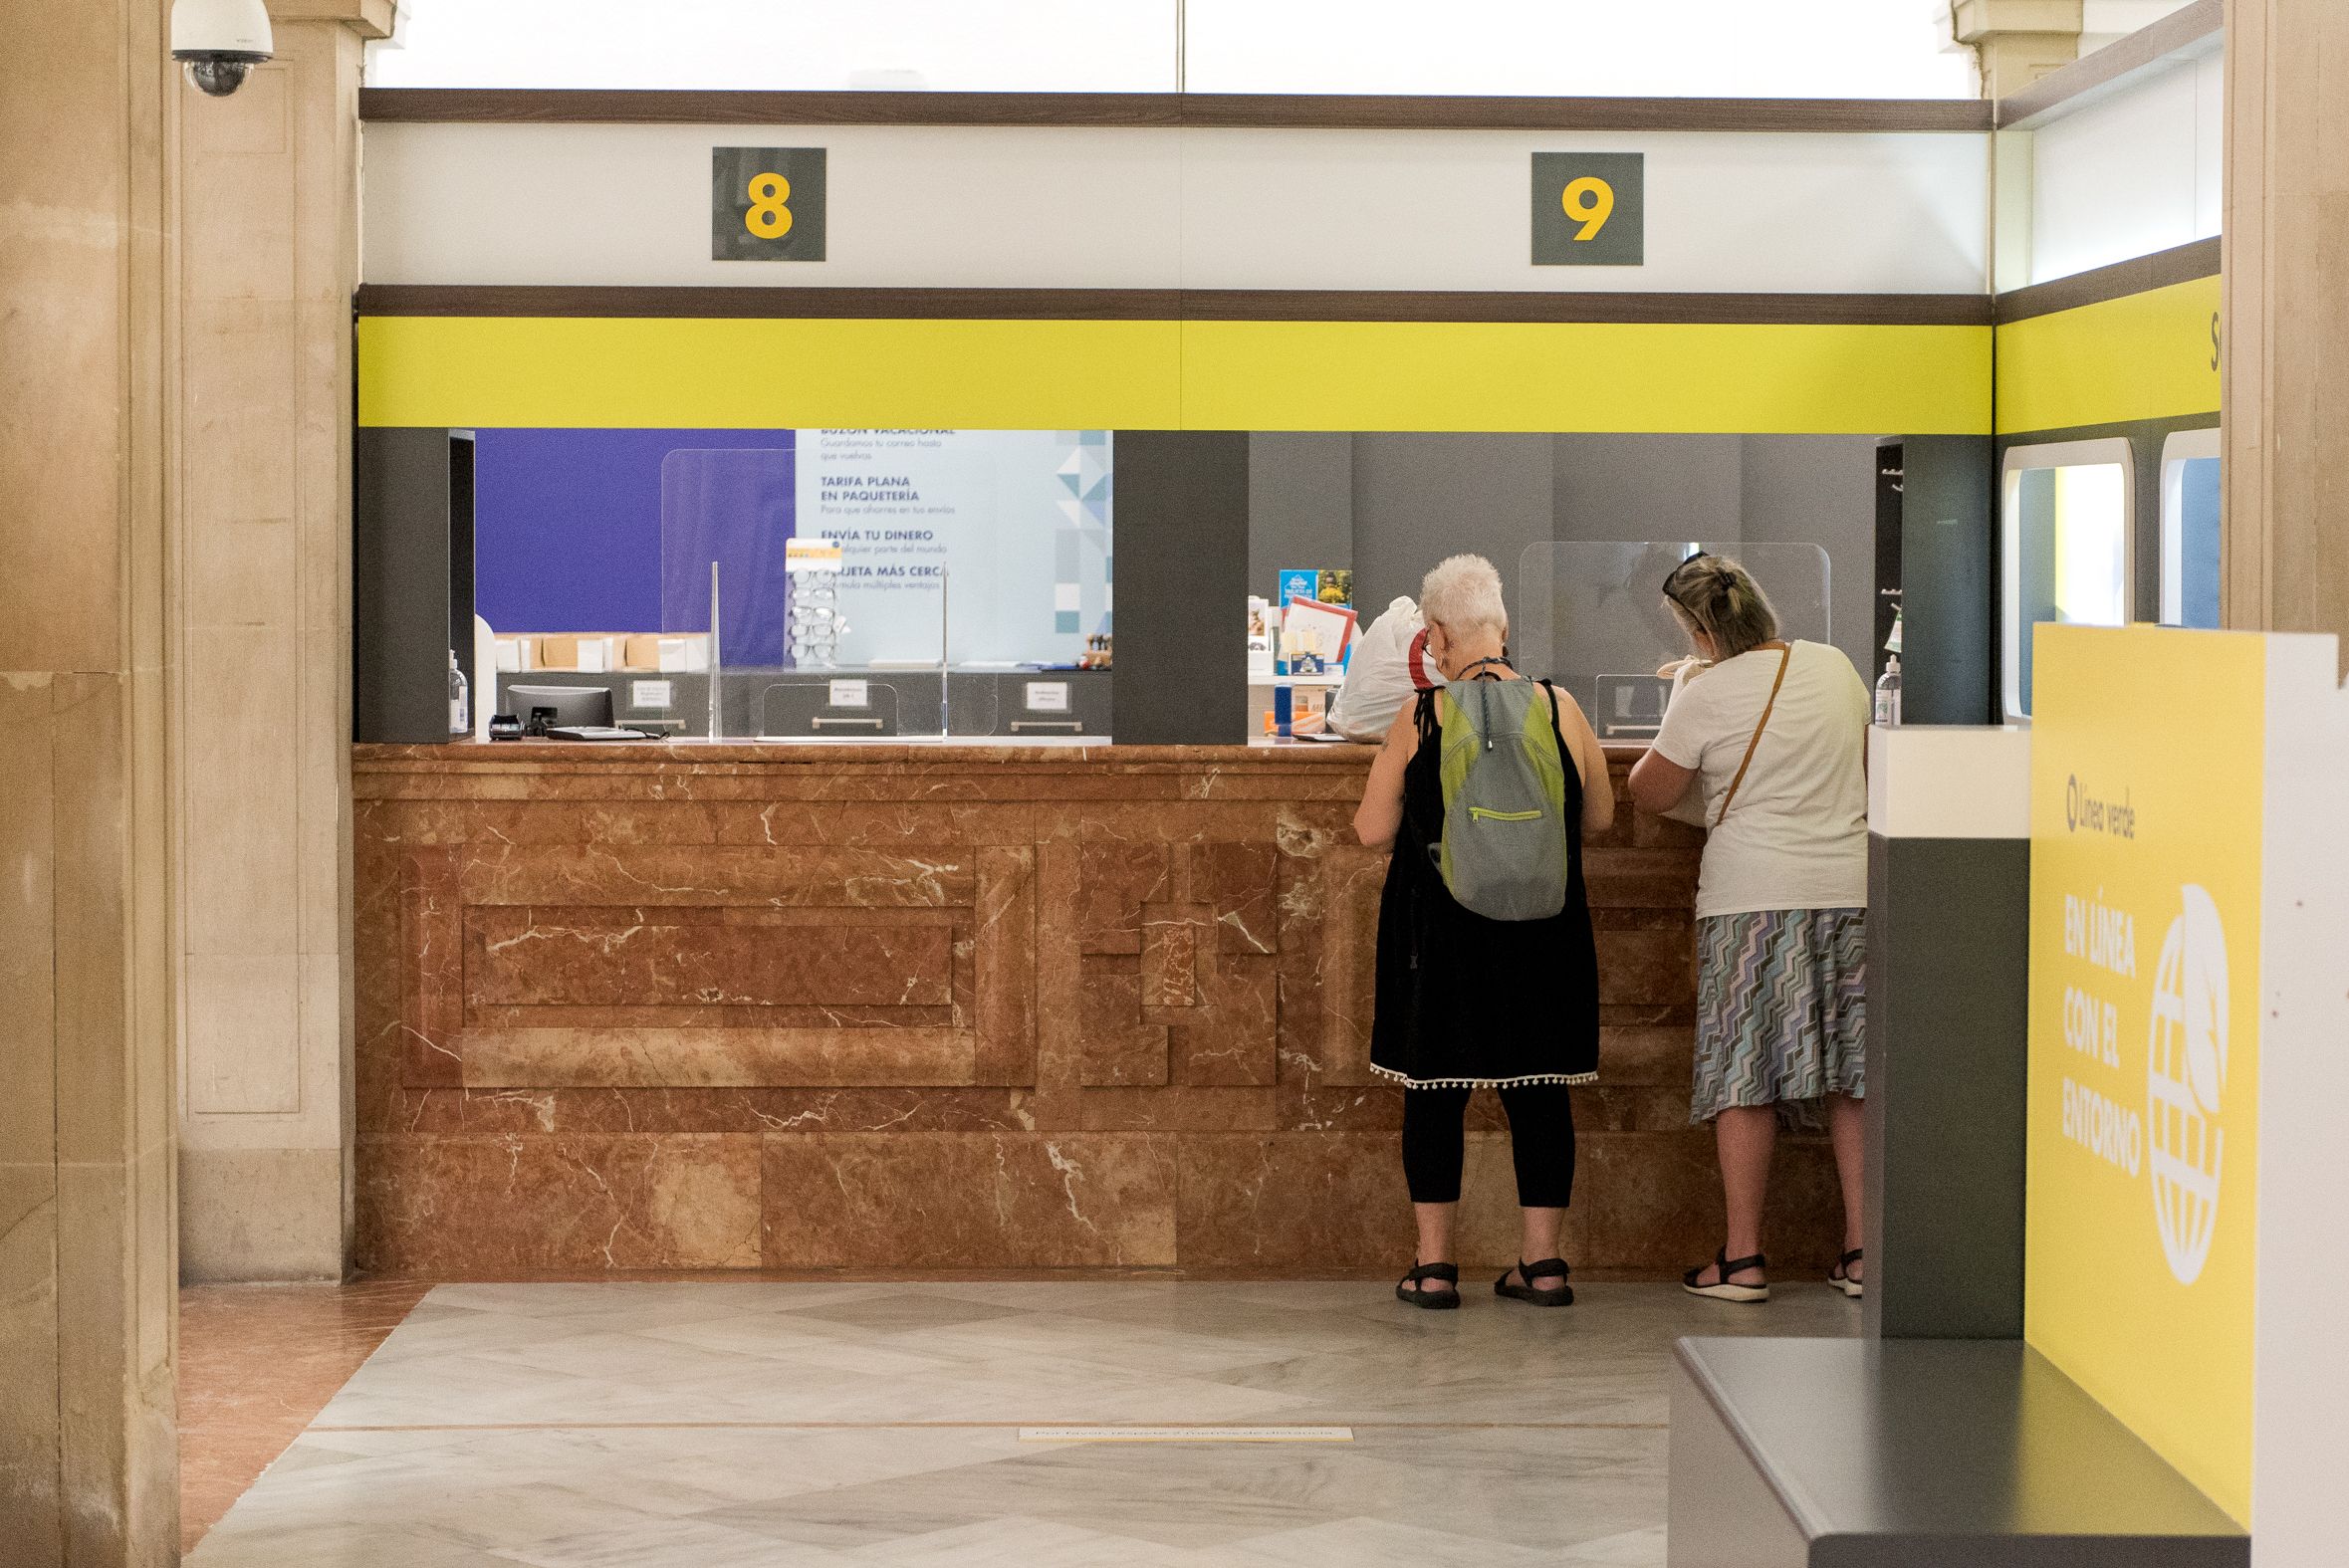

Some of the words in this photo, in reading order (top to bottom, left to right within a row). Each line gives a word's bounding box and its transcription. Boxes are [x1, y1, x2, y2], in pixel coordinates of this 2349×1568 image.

[745, 172, 793, 240] 8
[1561, 176, 1614, 241] 9
[2211, 311, 2222, 372] S
[822, 476, 863, 486] TARIFA
[867, 476, 910, 486] PLANA
[822, 491, 837, 502] EN
[843, 488, 919, 502] PAQUETERÍA
[822, 528, 860, 540] ENVÍA
[865, 530, 880, 540] TU
[884, 530, 933, 540] DINERO
[877, 562, 905, 576] MÁS
[2064, 894, 2086, 959] EN
[2089, 884, 2136, 979] LÍNEA
[2063, 986, 2099, 1060] CON
[2102, 1003, 2119, 1068] EL
[2062, 1077, 2140, 1179] ENTORNO
